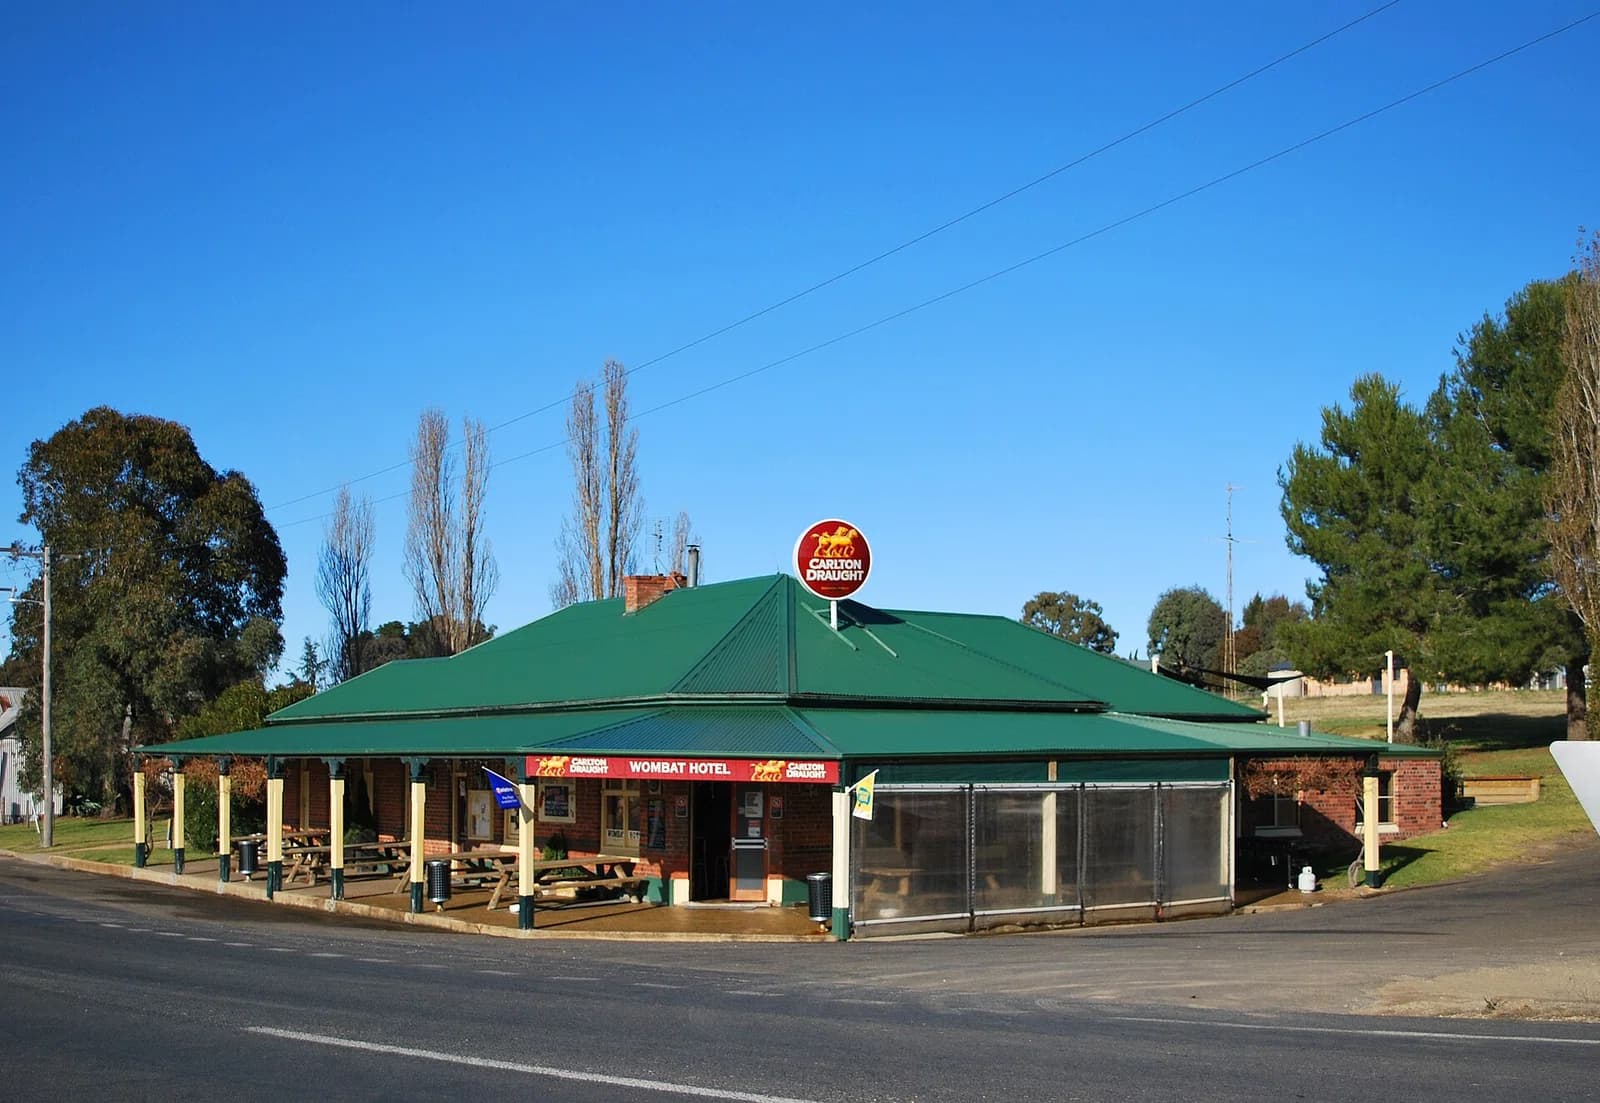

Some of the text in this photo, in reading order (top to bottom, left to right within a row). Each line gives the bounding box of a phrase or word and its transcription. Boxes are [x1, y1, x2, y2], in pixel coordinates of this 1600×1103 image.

[809, 558, 862, 569] CARLTON
[806, 569, 864, 581] DRAUGHT
[571, 757, 607, 766] CARLTON
[788, 762, 824, 770] CARLTON
[569, 765, 608, 773] DRAUGHT
[629, 761, 731, 774] WOMBAT HOTEL
[786, 769, 826, 778] DRAUGHT
